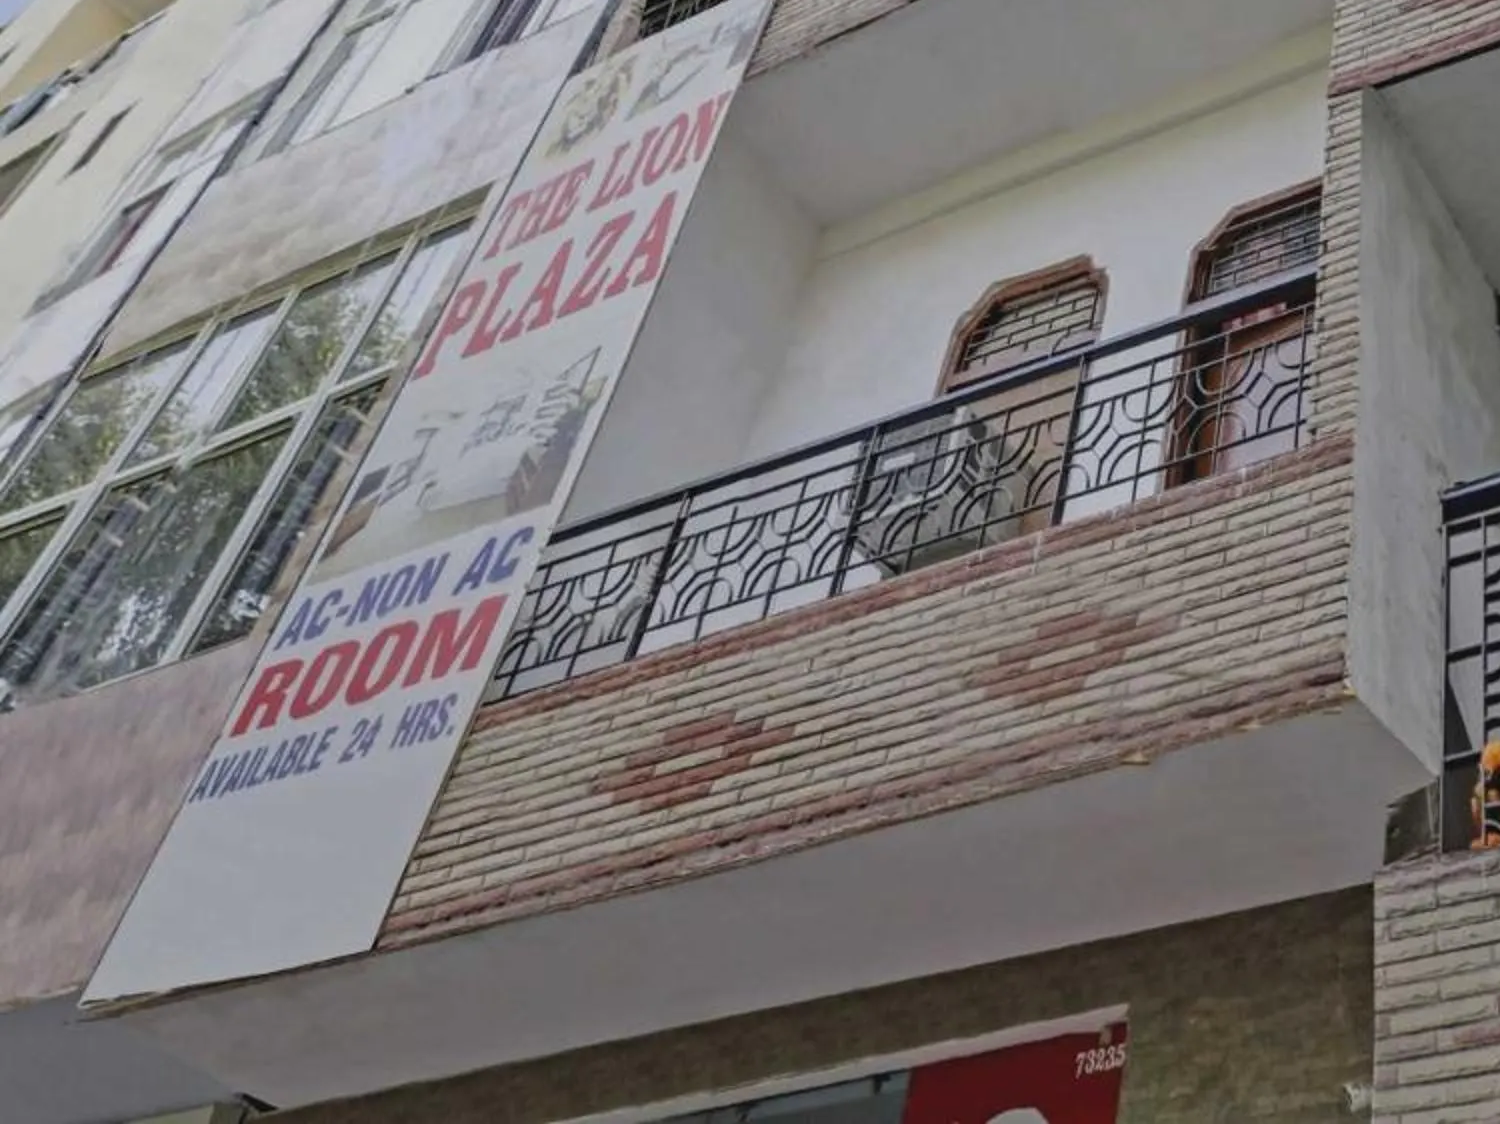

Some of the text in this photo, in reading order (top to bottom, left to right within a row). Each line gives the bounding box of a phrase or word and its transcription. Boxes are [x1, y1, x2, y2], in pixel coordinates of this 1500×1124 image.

[483, 89, 734, 261] THE LION
[411, 190, 677, 381] PLAZA
[276, 525, 535, 651] AC-NON AC
[231, 593, 508, 736] ROOM
[188, 692, 458, 804] AVAILABLE 24 HRS.
